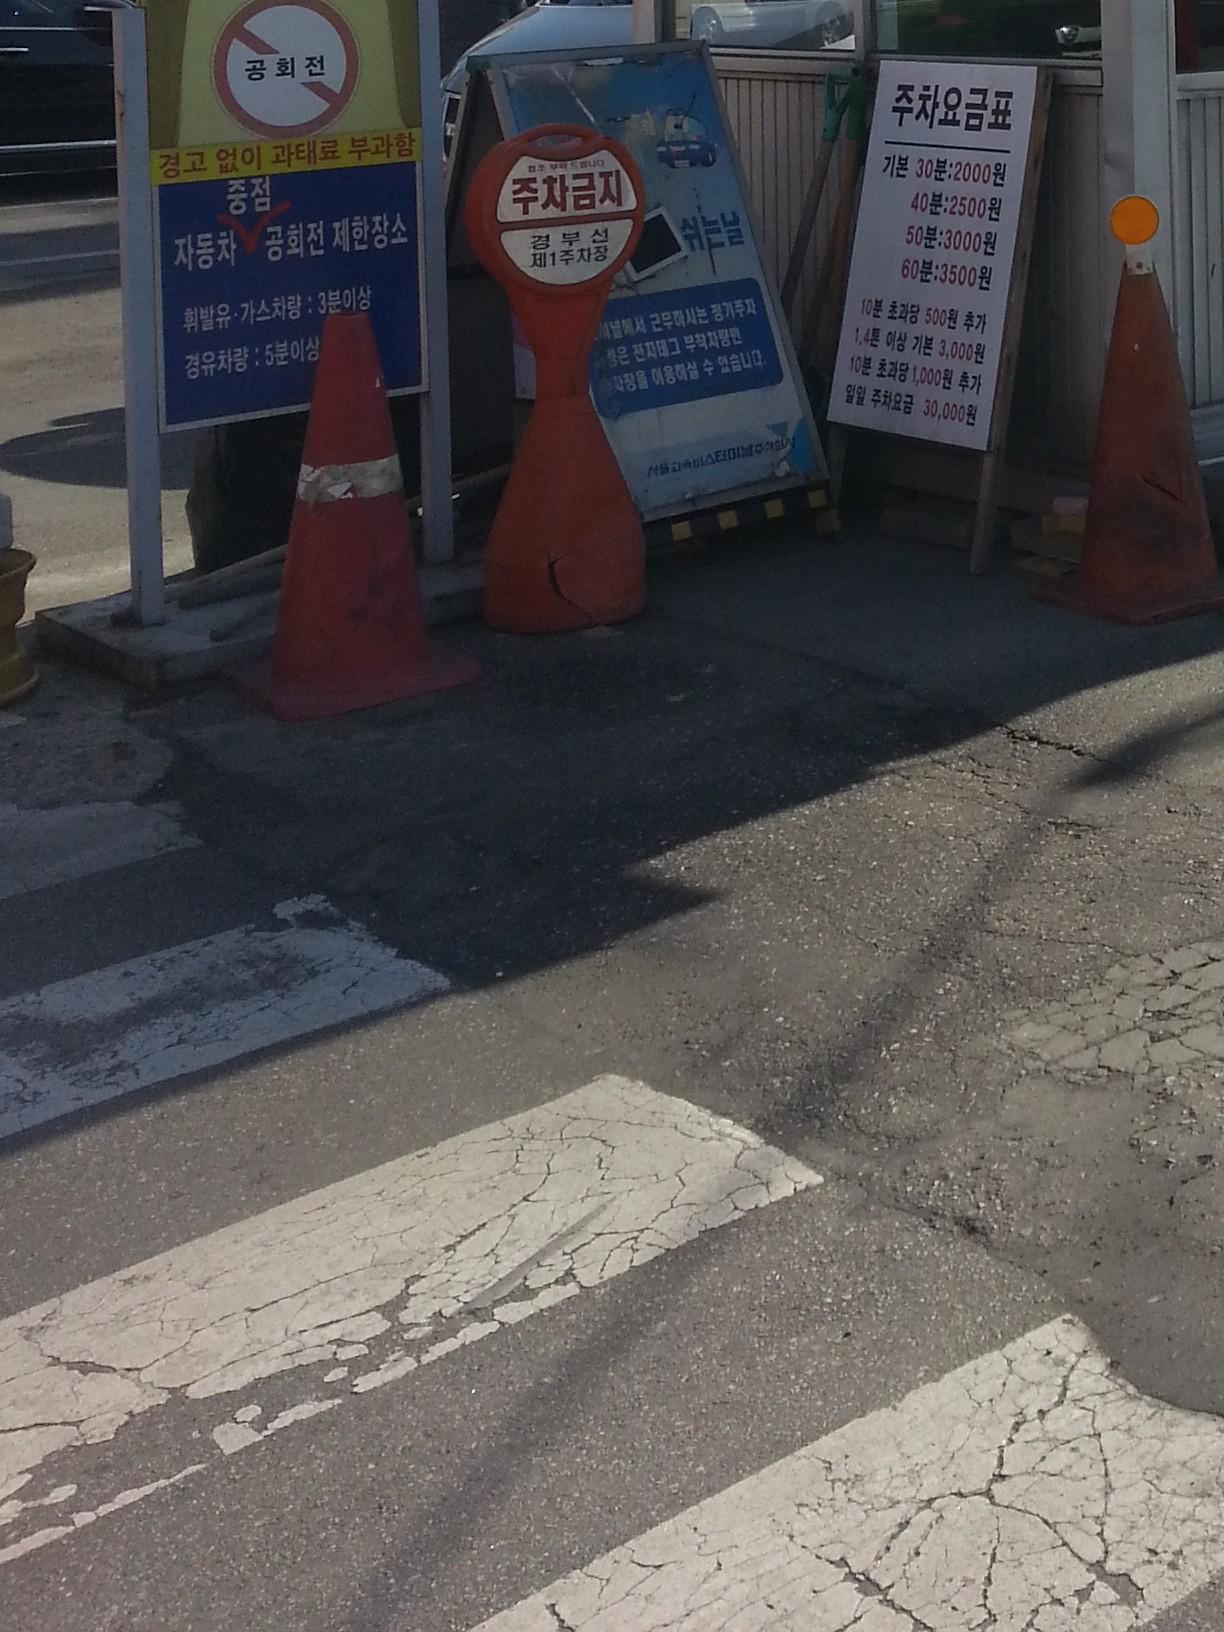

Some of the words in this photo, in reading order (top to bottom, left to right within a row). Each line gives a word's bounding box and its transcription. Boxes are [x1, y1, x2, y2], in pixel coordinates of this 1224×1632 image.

[245, 54, 326, 81] 공회전
[892, 84, 1013, 131] 주차요금표
[159, 151, 207, 179] 경고
[216, 145, 262, 175] 없이
[271, 139, 341, 168] 과태료
[348, 132, 417, 161] 부과함
[883, 154, 909, 179] 기본
[916, 158, 1006, 187] 30분:2000원
[226, 176, 271, 216] 중점
[512, 170, 623, 215] 주차금지
[911, 191, 1002, 222] 40분:2500원
[174, 229, 237, 272] 자동차
[264, 219, 325, 262] 공회전
[332, 212, 408, 254] 제한장소
[530, 245, 608, 268] 제1주차장
[905, 225, 997, 257] 50분:3000원
[901, 258, 992, 291] 60분:3500원
[318, 285, 372, 315] 3분이상
[861, 298, 883, 318] 10분
[887, 300, 920, 325] 초과당
[924, 307, 959, 330] 500원
[963, 311, 987, 335] 추가
[185, 345, 249, 380] 경유차량
[265, 336, 320, 367] 5분이상
[886, 330, 907, 352] 이상
[912, 334, 934, 356] 기본
[938, 339, 986, 365] 3,000원
[703, 358, 715, 377] 수
[850, 354, 872, 376] 10분
[876, 358, 909, 383] 초과당
[912, 366, 953, 390] 1,000원
[958, 371, 982, 395] 추가
[845, 383, 866, 406] 일일
[871, 388, 914, 415] 주차요금
[923, 398, 977, 426] 30,000원
